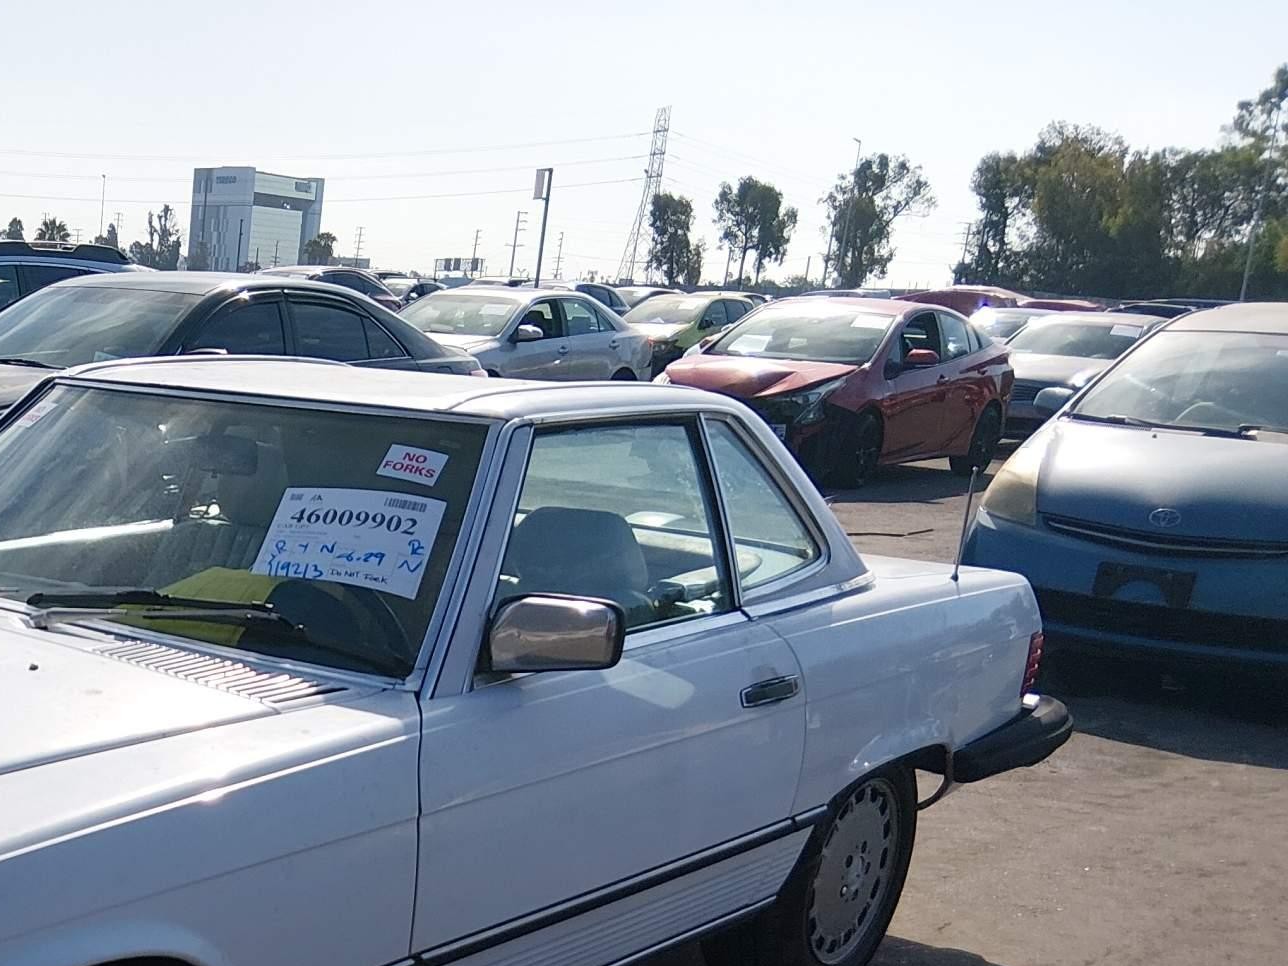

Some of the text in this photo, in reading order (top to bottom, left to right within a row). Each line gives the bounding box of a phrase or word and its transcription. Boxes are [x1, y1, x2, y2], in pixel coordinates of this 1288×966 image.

[403, 451, 428, 464] NO
[383, 460, 436, 479] FORKS
[290, 507, 419, 535] 46009902
